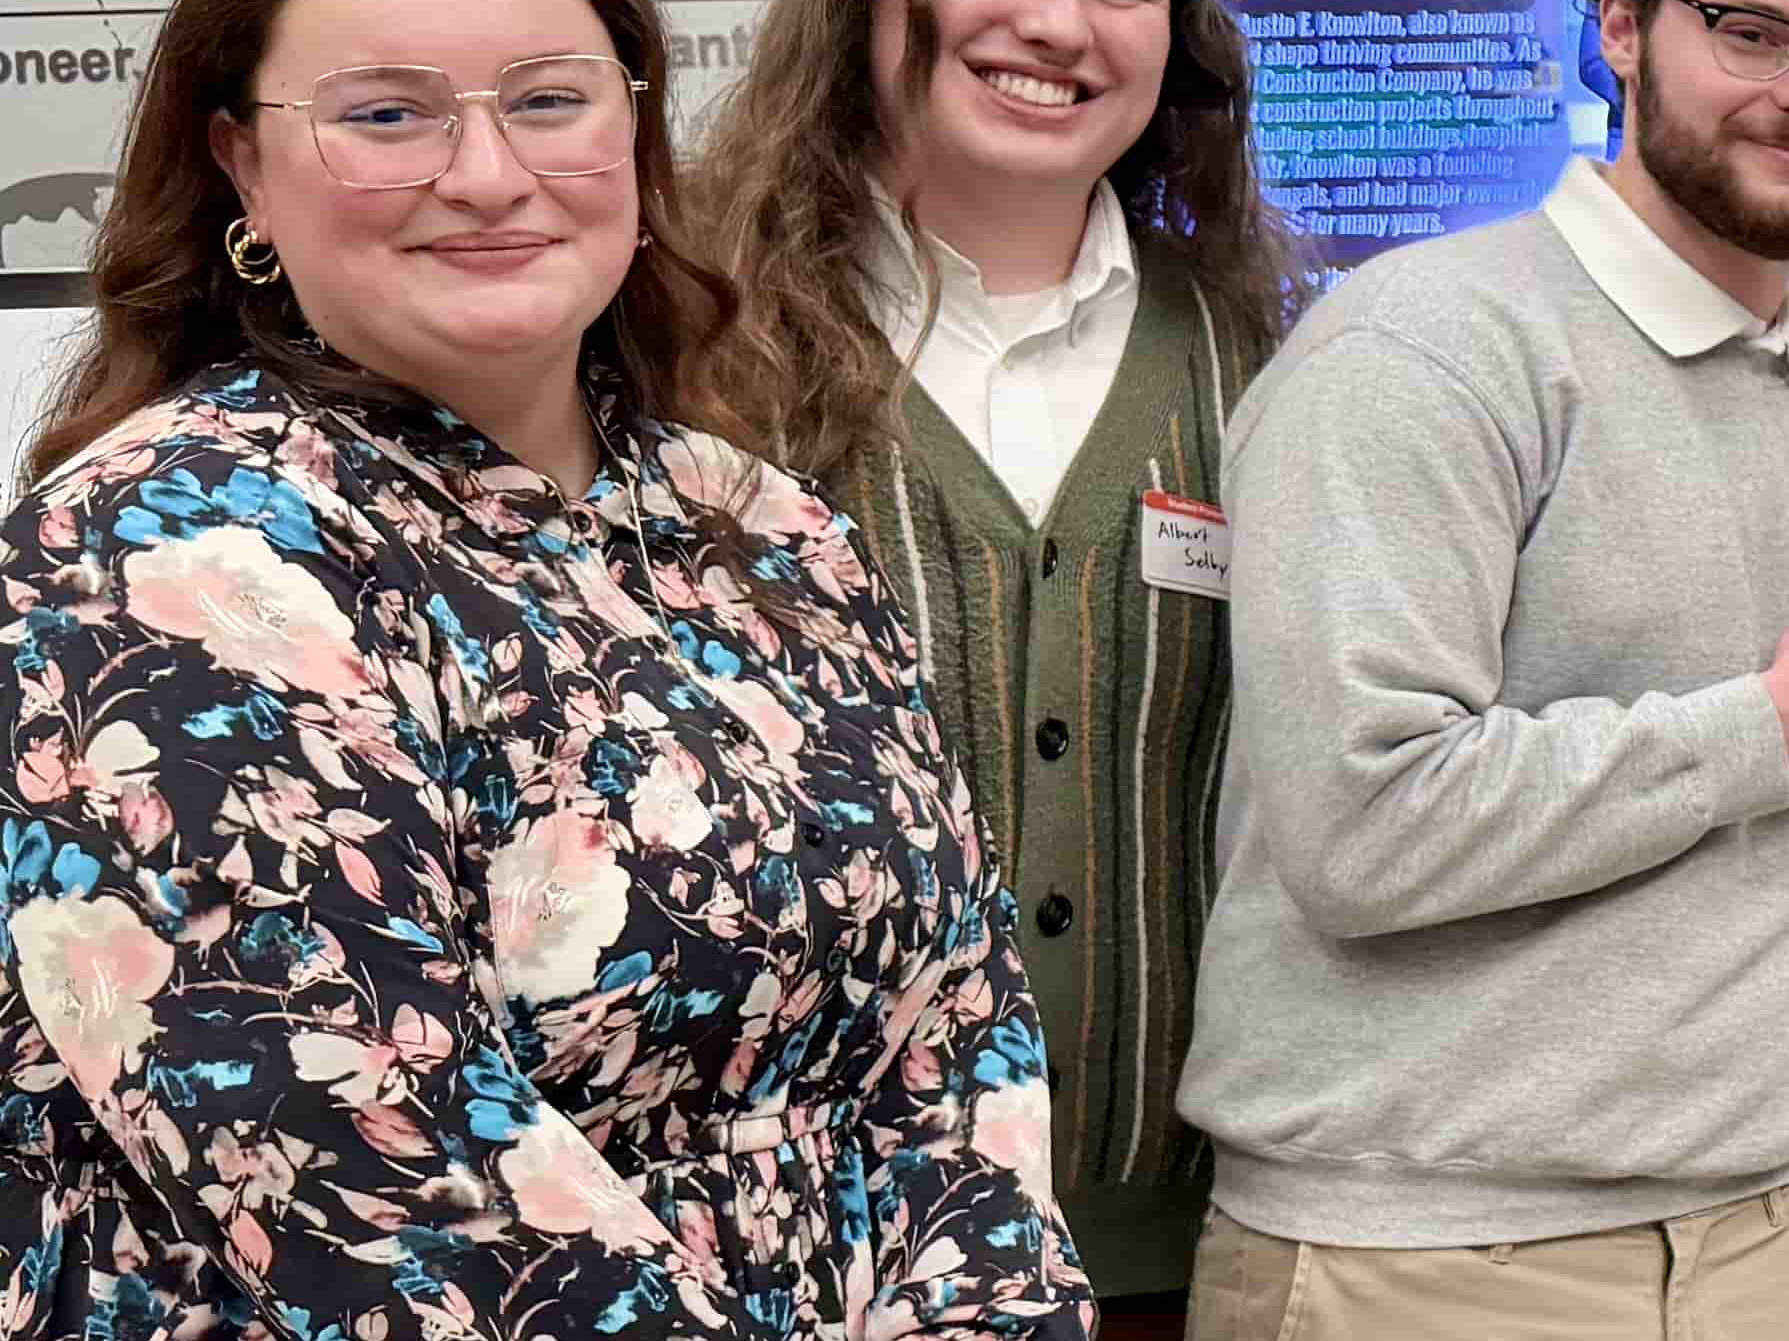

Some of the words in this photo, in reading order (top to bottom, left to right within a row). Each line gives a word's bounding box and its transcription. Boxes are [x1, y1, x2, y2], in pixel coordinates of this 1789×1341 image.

[1316, 10, 1407, 39] Knowlton,
[1407, 9, 1448, 36] also
[1449, 9, 1509, 35] known
[1319, 39, 1393, 69] thriving
[1263, 69, 1375, 94] Construction
[1376, 67, 1466, 96] Company,
[1263, 98, 1375, 123] construction
[1377, 97, 1452, 126] projects
[1453, 95, 1555, 124] throughout
[1315, 125, 1375, 150] school
[1293, 153, 1376, 179] Knowlton
[1378, 156, 1416, 177] was
[1332, 181, 1370, 206] and
[1371, 180, 1407, 206] had
[1409, 180, 1462, 208] major
[1340, 213, 1388, 237] many
